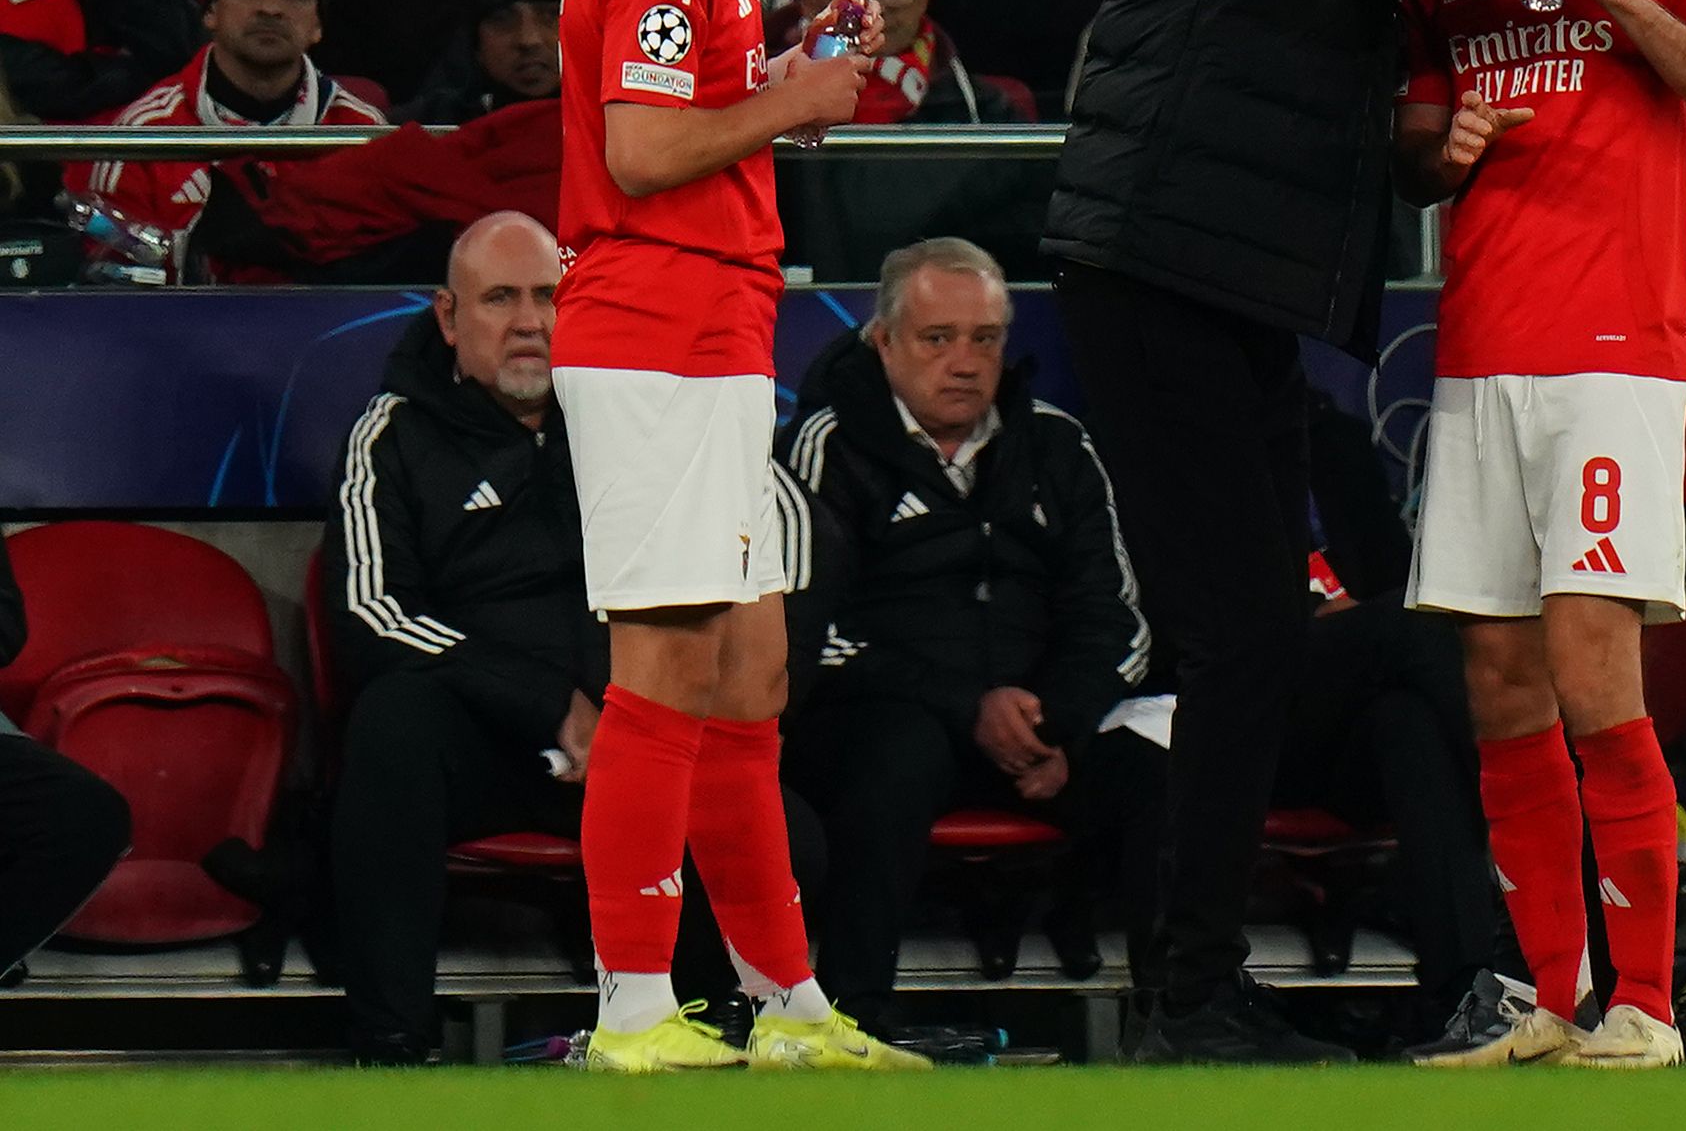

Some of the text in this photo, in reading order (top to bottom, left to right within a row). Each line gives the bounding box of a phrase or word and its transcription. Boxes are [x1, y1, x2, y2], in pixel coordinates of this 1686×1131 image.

[1449, 15, 1613, 74] Emirates
[626, 70, 692, 88] FOUNDATION
[1475, 58, 1585, 104] FLY BETTER
[1581, 456, 1621, 534] 8
